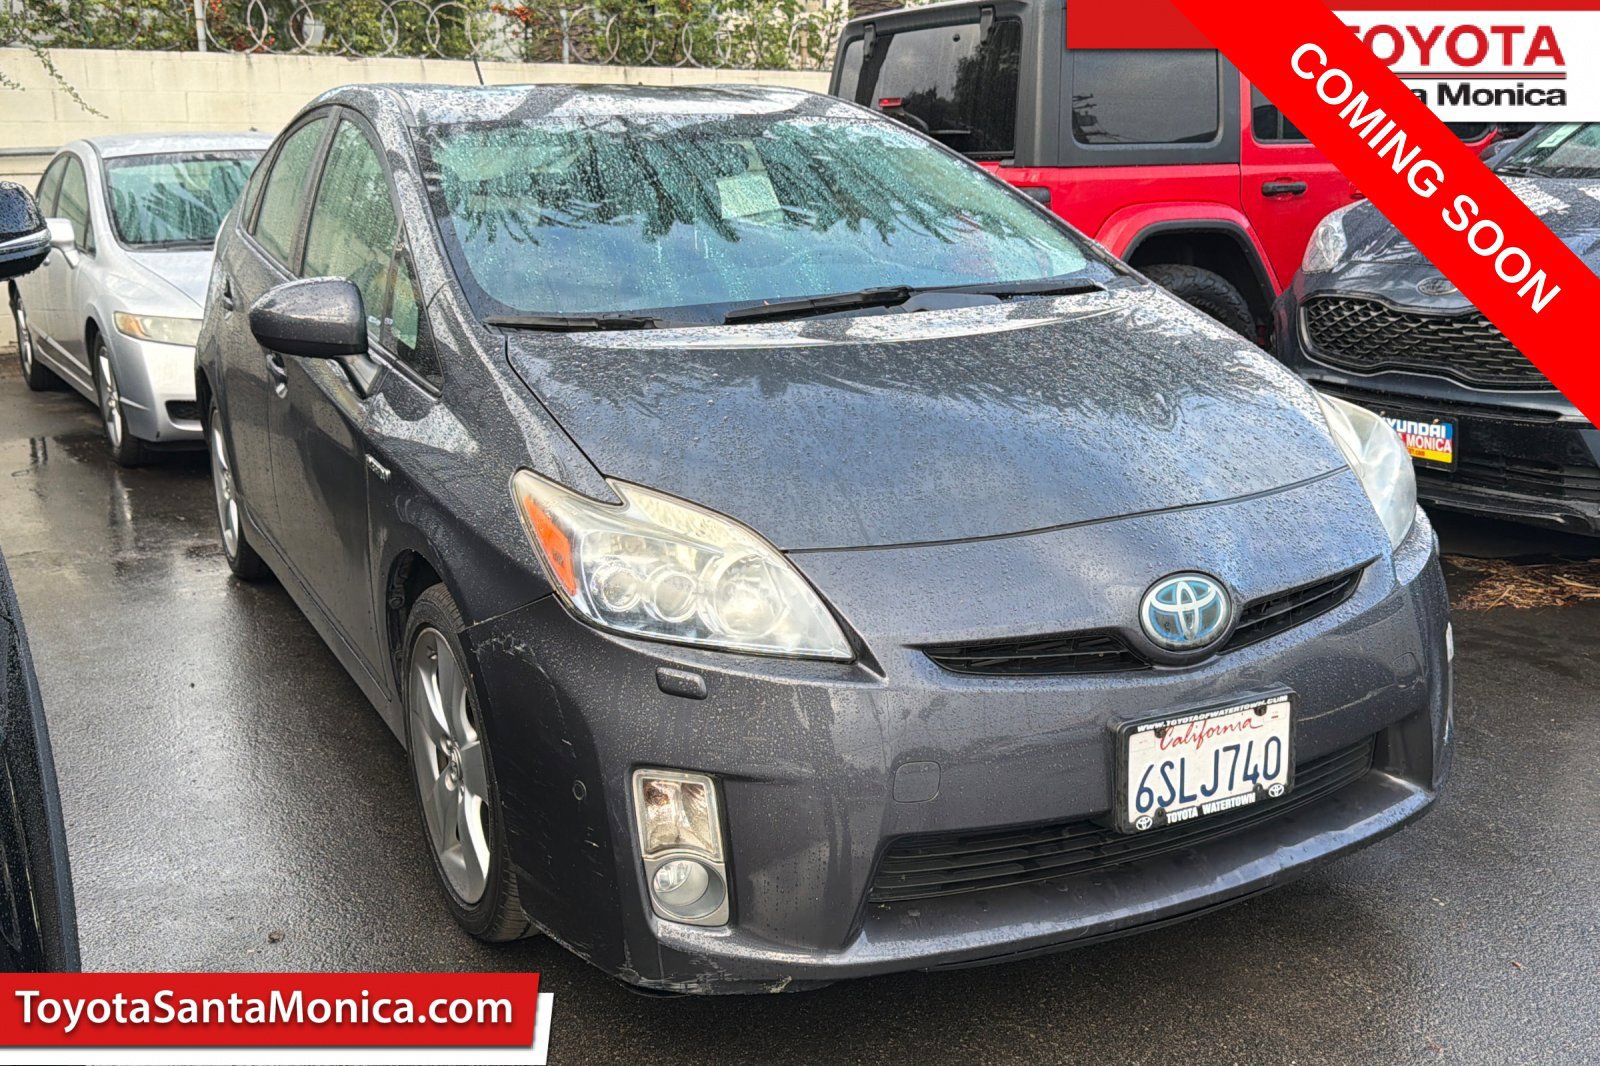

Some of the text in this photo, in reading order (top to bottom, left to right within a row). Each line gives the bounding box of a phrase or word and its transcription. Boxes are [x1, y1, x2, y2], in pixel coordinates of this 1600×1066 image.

[1382, 417, 1446, 438] YUNDAI
[1406, 434, 1452, 453] MONICA
[1159, 717, 1263, 750] California
[1136, 735, 1281, 813] 6SLJ740
[1166, 793, 1256, 824] TOYOTA WATERTOWN
